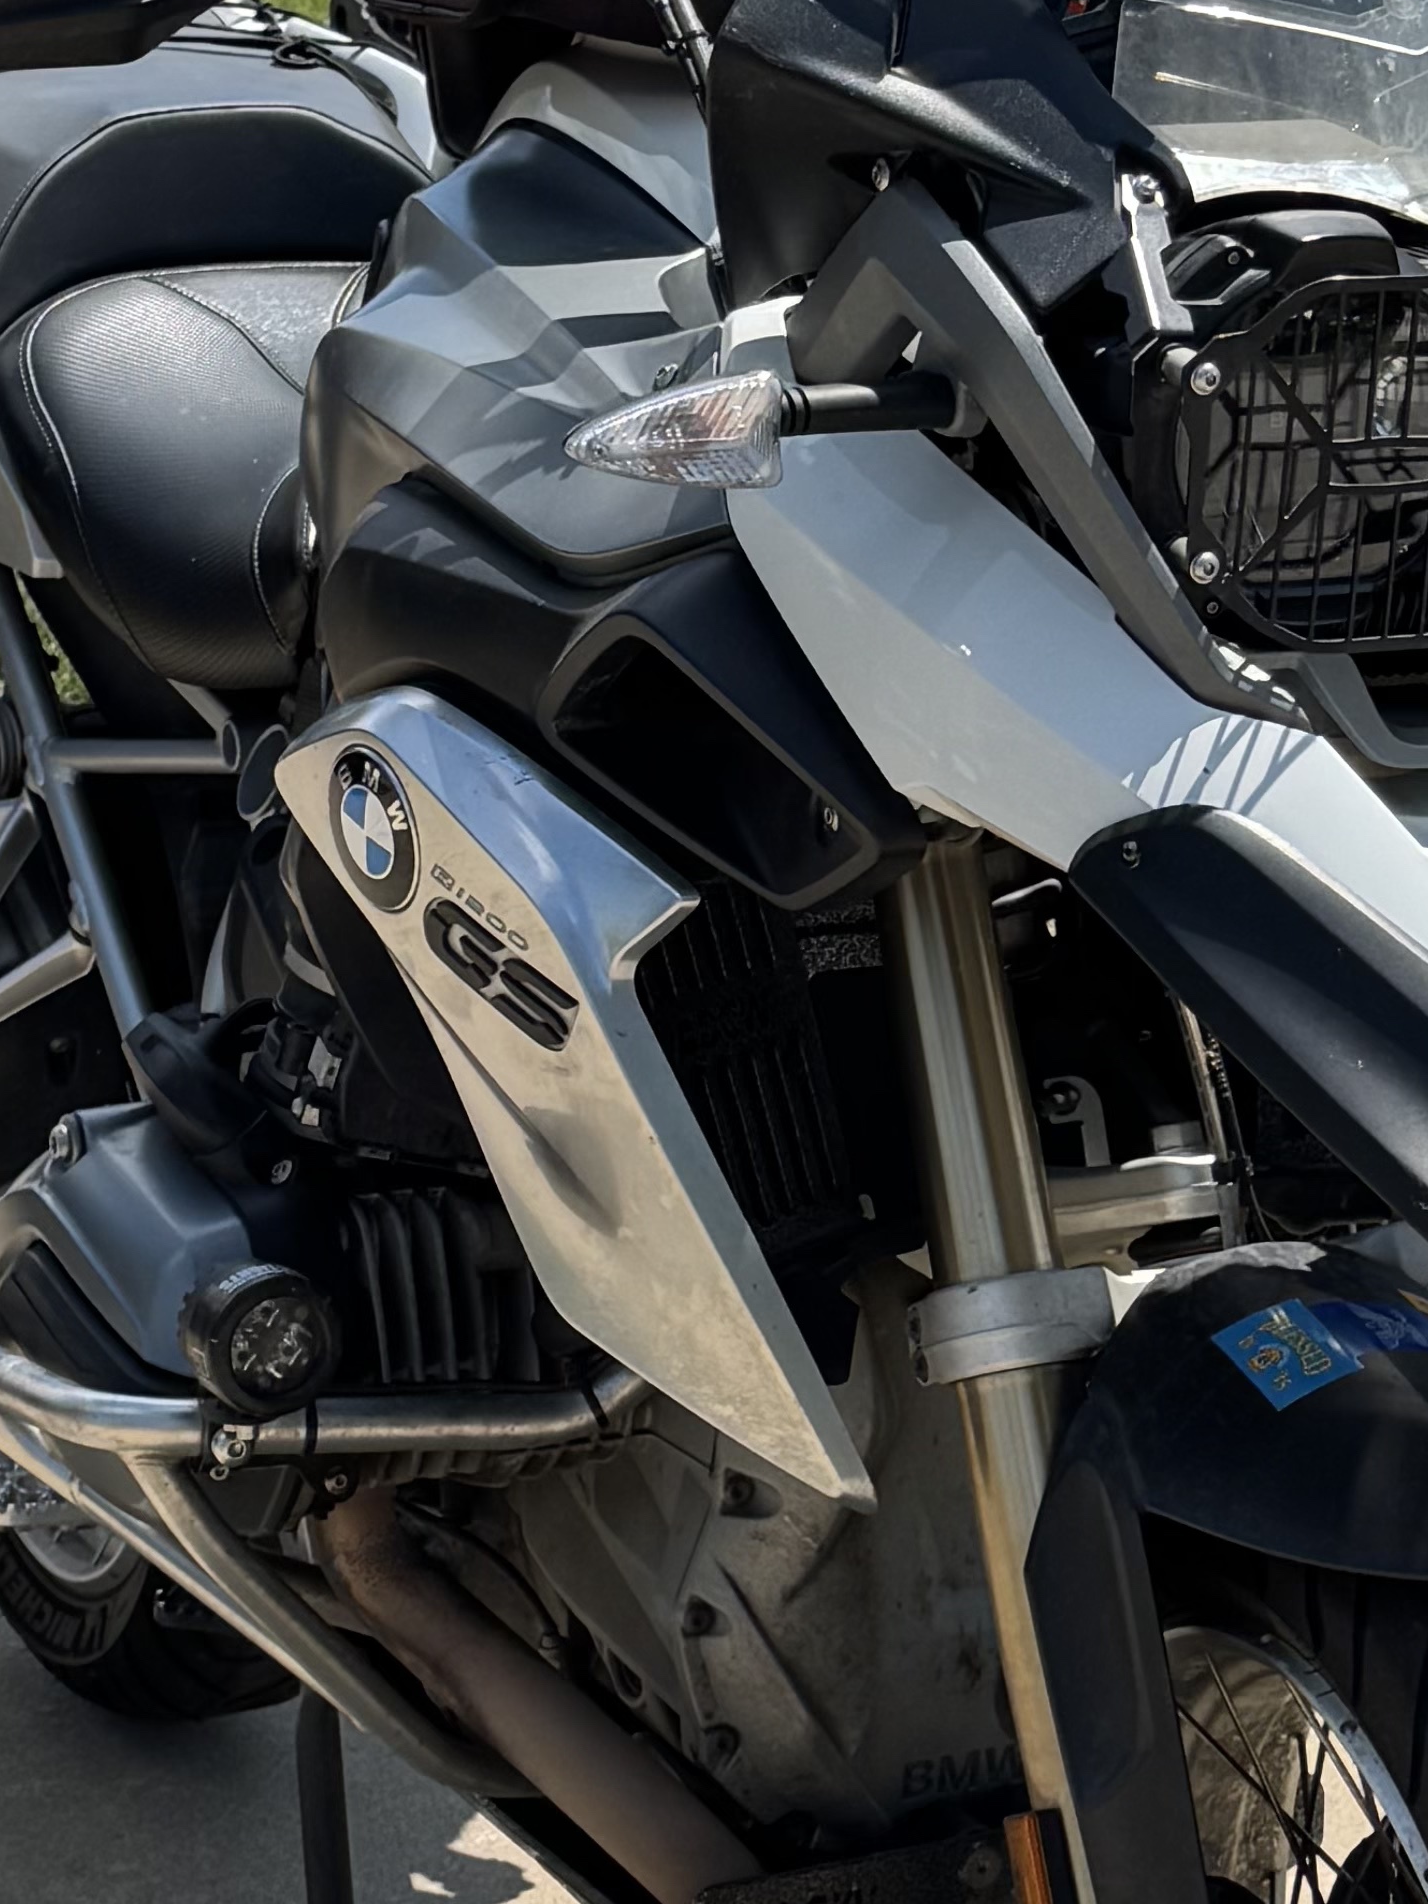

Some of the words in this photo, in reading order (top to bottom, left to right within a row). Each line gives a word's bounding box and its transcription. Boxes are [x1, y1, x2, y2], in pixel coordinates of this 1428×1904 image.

[336, 760, 409, 833] BMW
[430, 863, 529, 953] R1200
[423, 896, 580, 1053] GS
